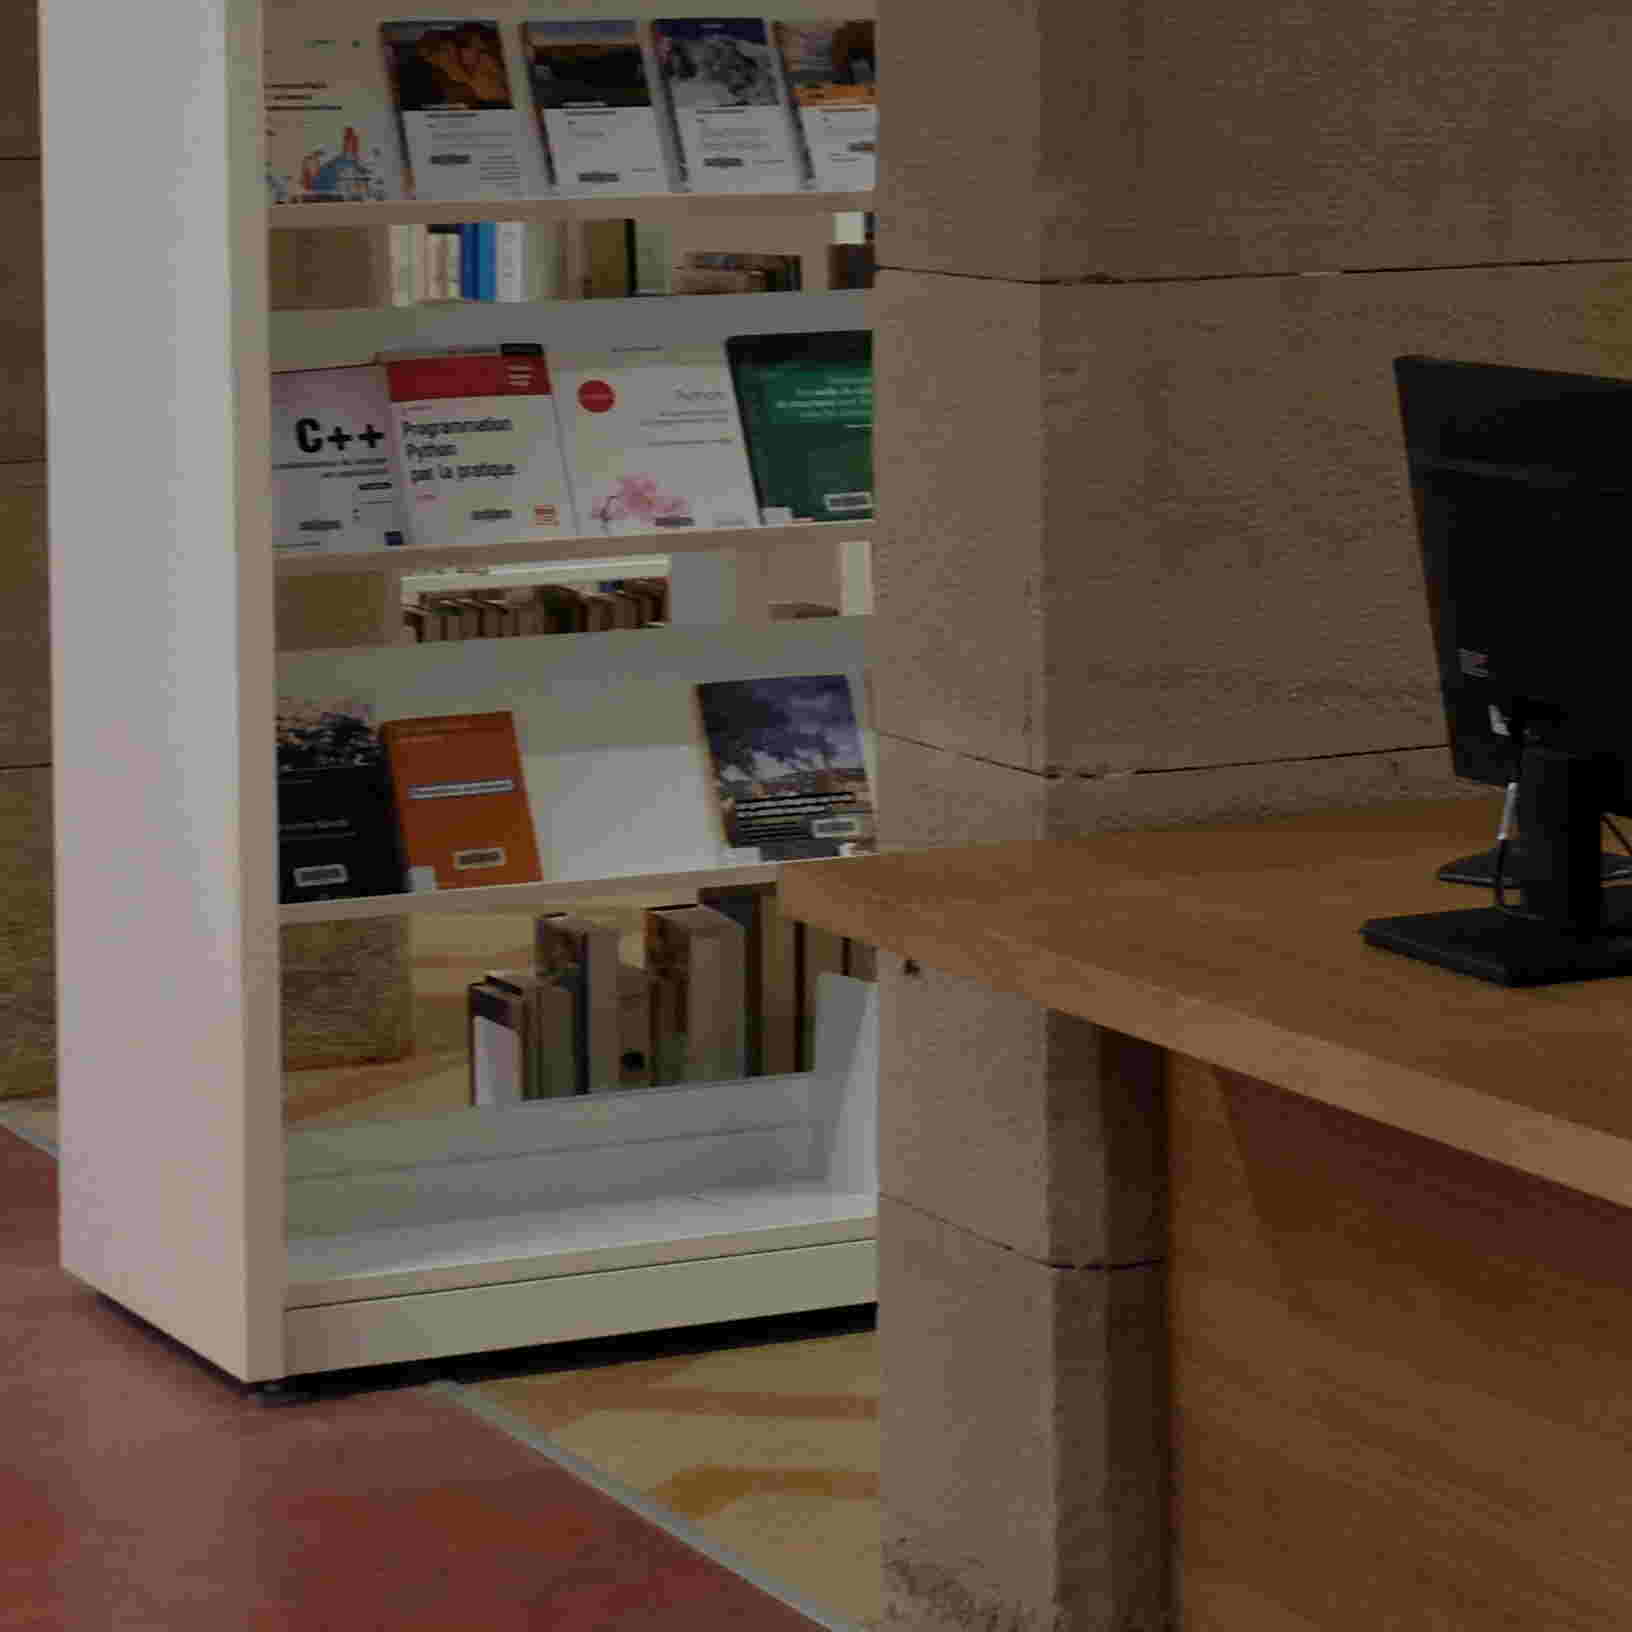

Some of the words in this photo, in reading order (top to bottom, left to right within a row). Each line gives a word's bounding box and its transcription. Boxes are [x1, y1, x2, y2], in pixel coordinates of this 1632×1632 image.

[294, 416, 385, 455] C++
[401, 417, 513, 438] Programmation
[405, 442, 457, 462] Python
[458, 462, 518, 481] pratique
